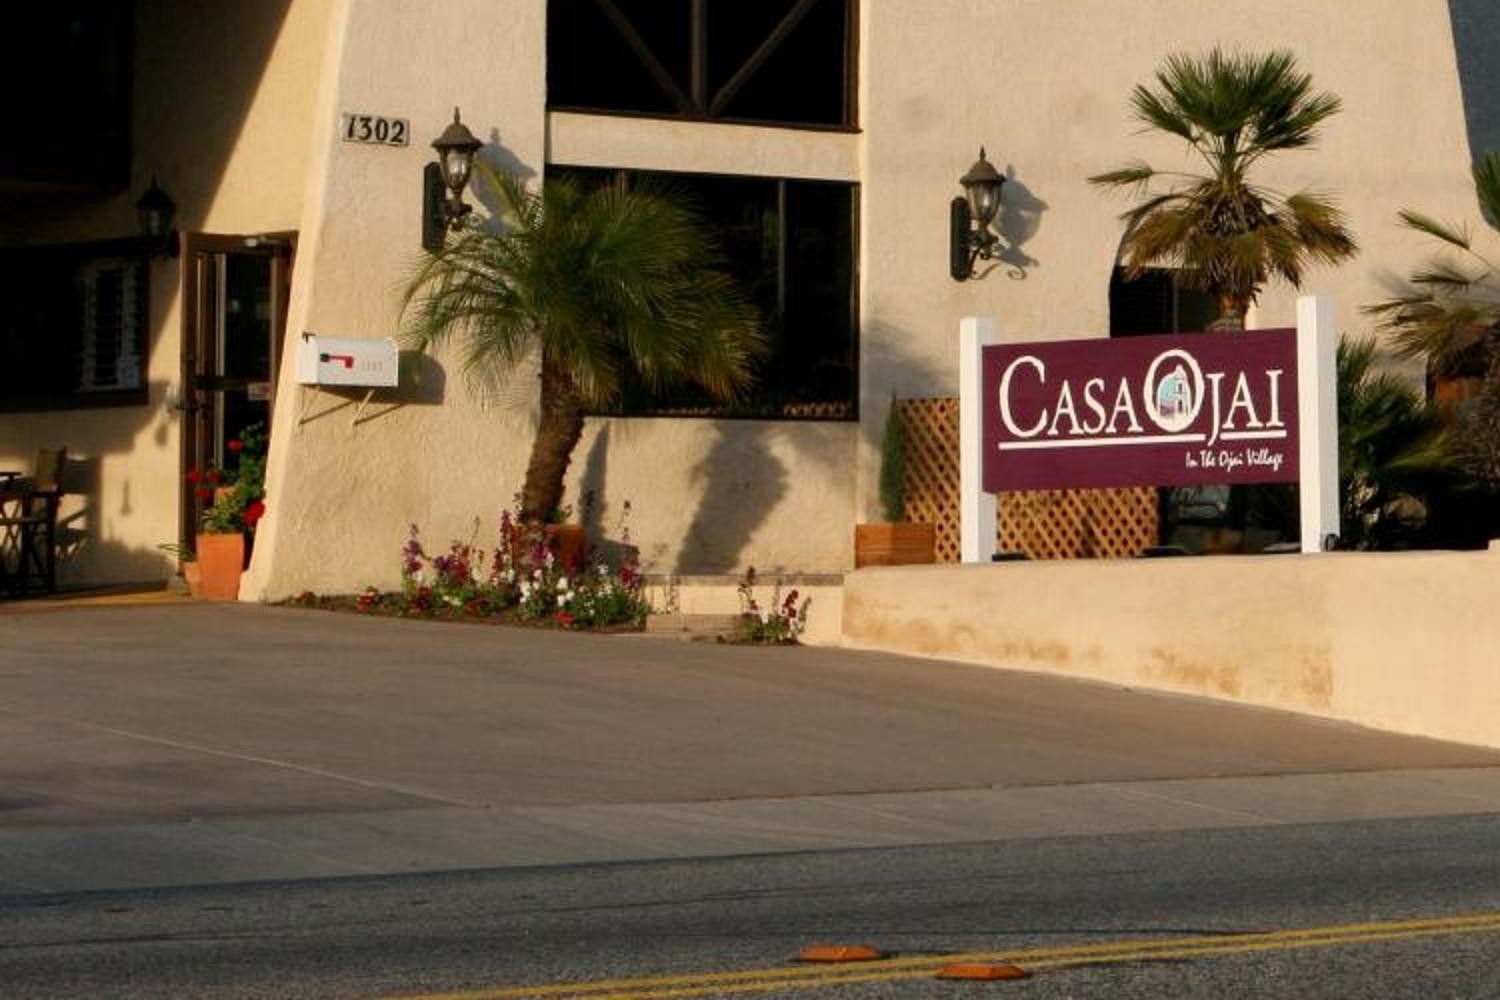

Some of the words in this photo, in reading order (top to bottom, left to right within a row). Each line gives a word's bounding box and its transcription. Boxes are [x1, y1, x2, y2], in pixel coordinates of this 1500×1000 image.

[347, 115, 404, 143] 1302
[1185, 450, 1198, 468] In
[1200, 449, 1215, 468] The
[1219, 450, 1243, 472] Ojai
[1246, 447, 1283, 472] Village
